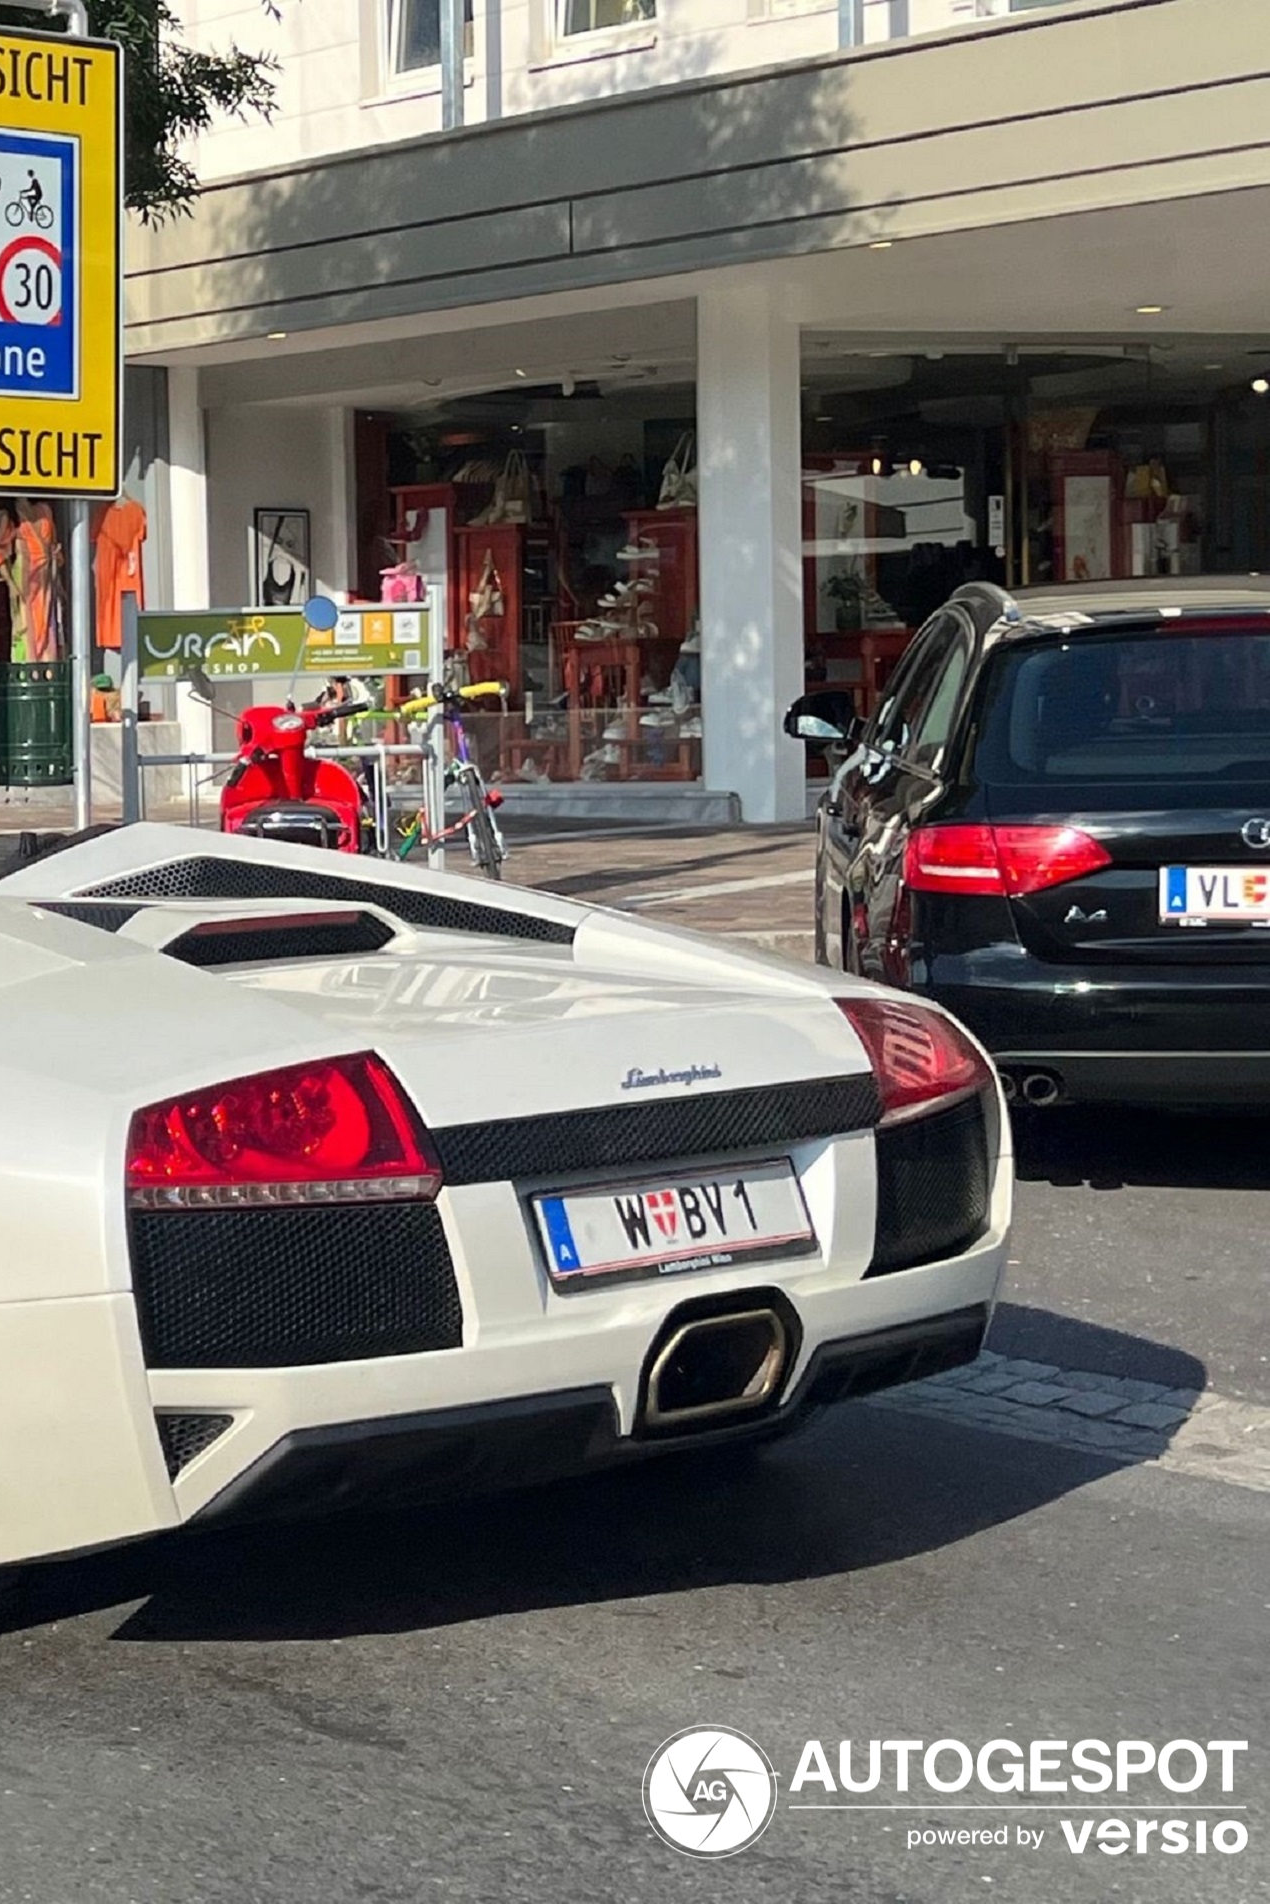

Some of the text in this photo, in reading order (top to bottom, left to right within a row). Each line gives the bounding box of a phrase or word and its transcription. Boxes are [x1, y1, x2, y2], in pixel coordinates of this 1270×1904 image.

[14, 262, 53, 311] 30
[1198, 874, 1239, 908] VL
[1064, 905, 1108, 924] A4
[621, 1062, 722, 1089] Lamborghini
[614, 1193, 652, 1250] W
[733, 1179, 758, 1231] 1
[560, 1243, 572, 1261] A
